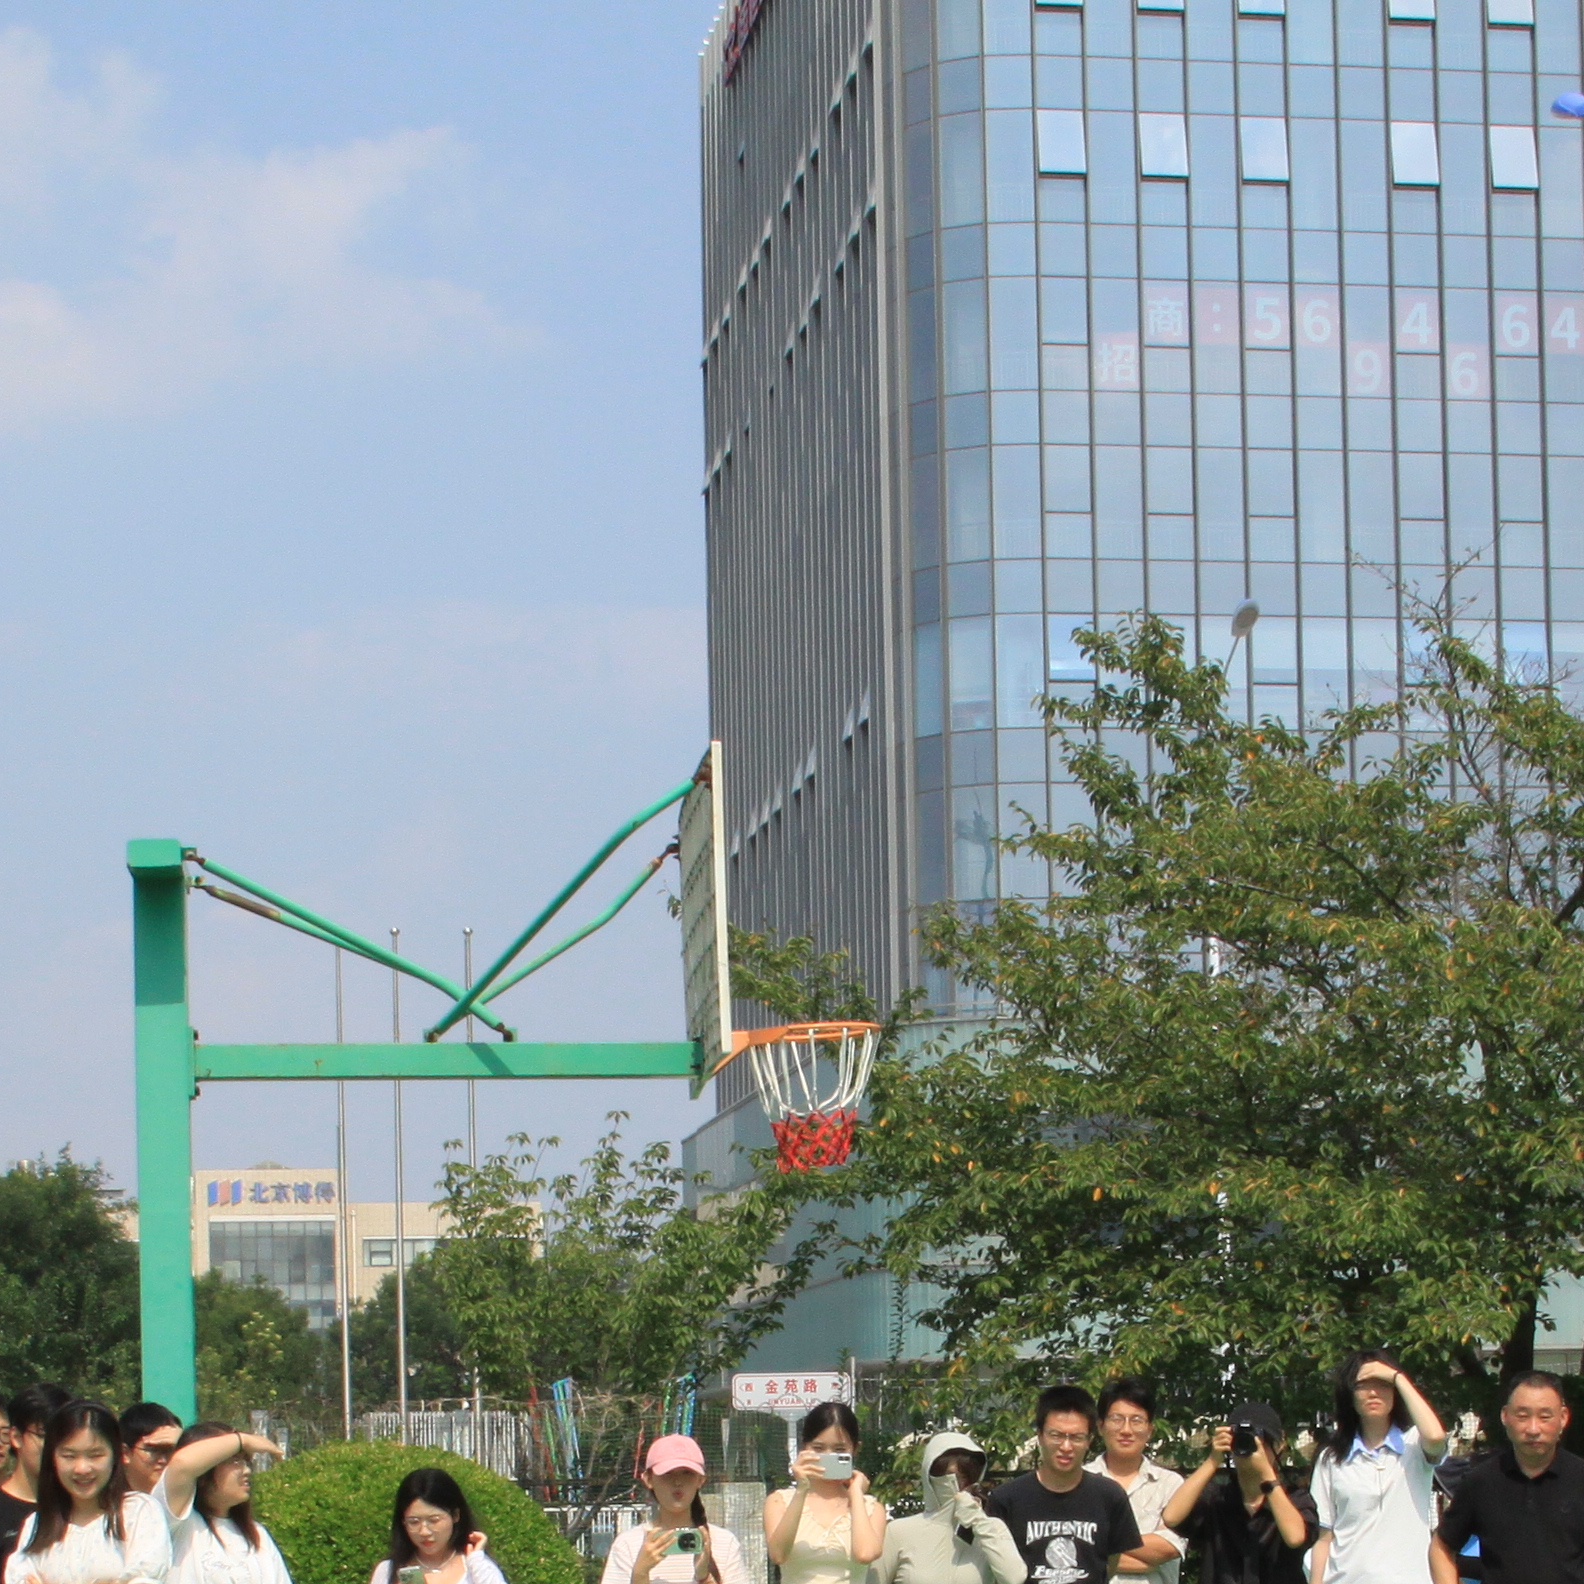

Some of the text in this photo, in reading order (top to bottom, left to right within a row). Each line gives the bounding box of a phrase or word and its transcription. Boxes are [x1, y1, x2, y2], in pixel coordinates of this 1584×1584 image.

[765, 1378, 818, 1394] 金苑路
[1026, 1520, 1098, 1546] AUTHENTIC
